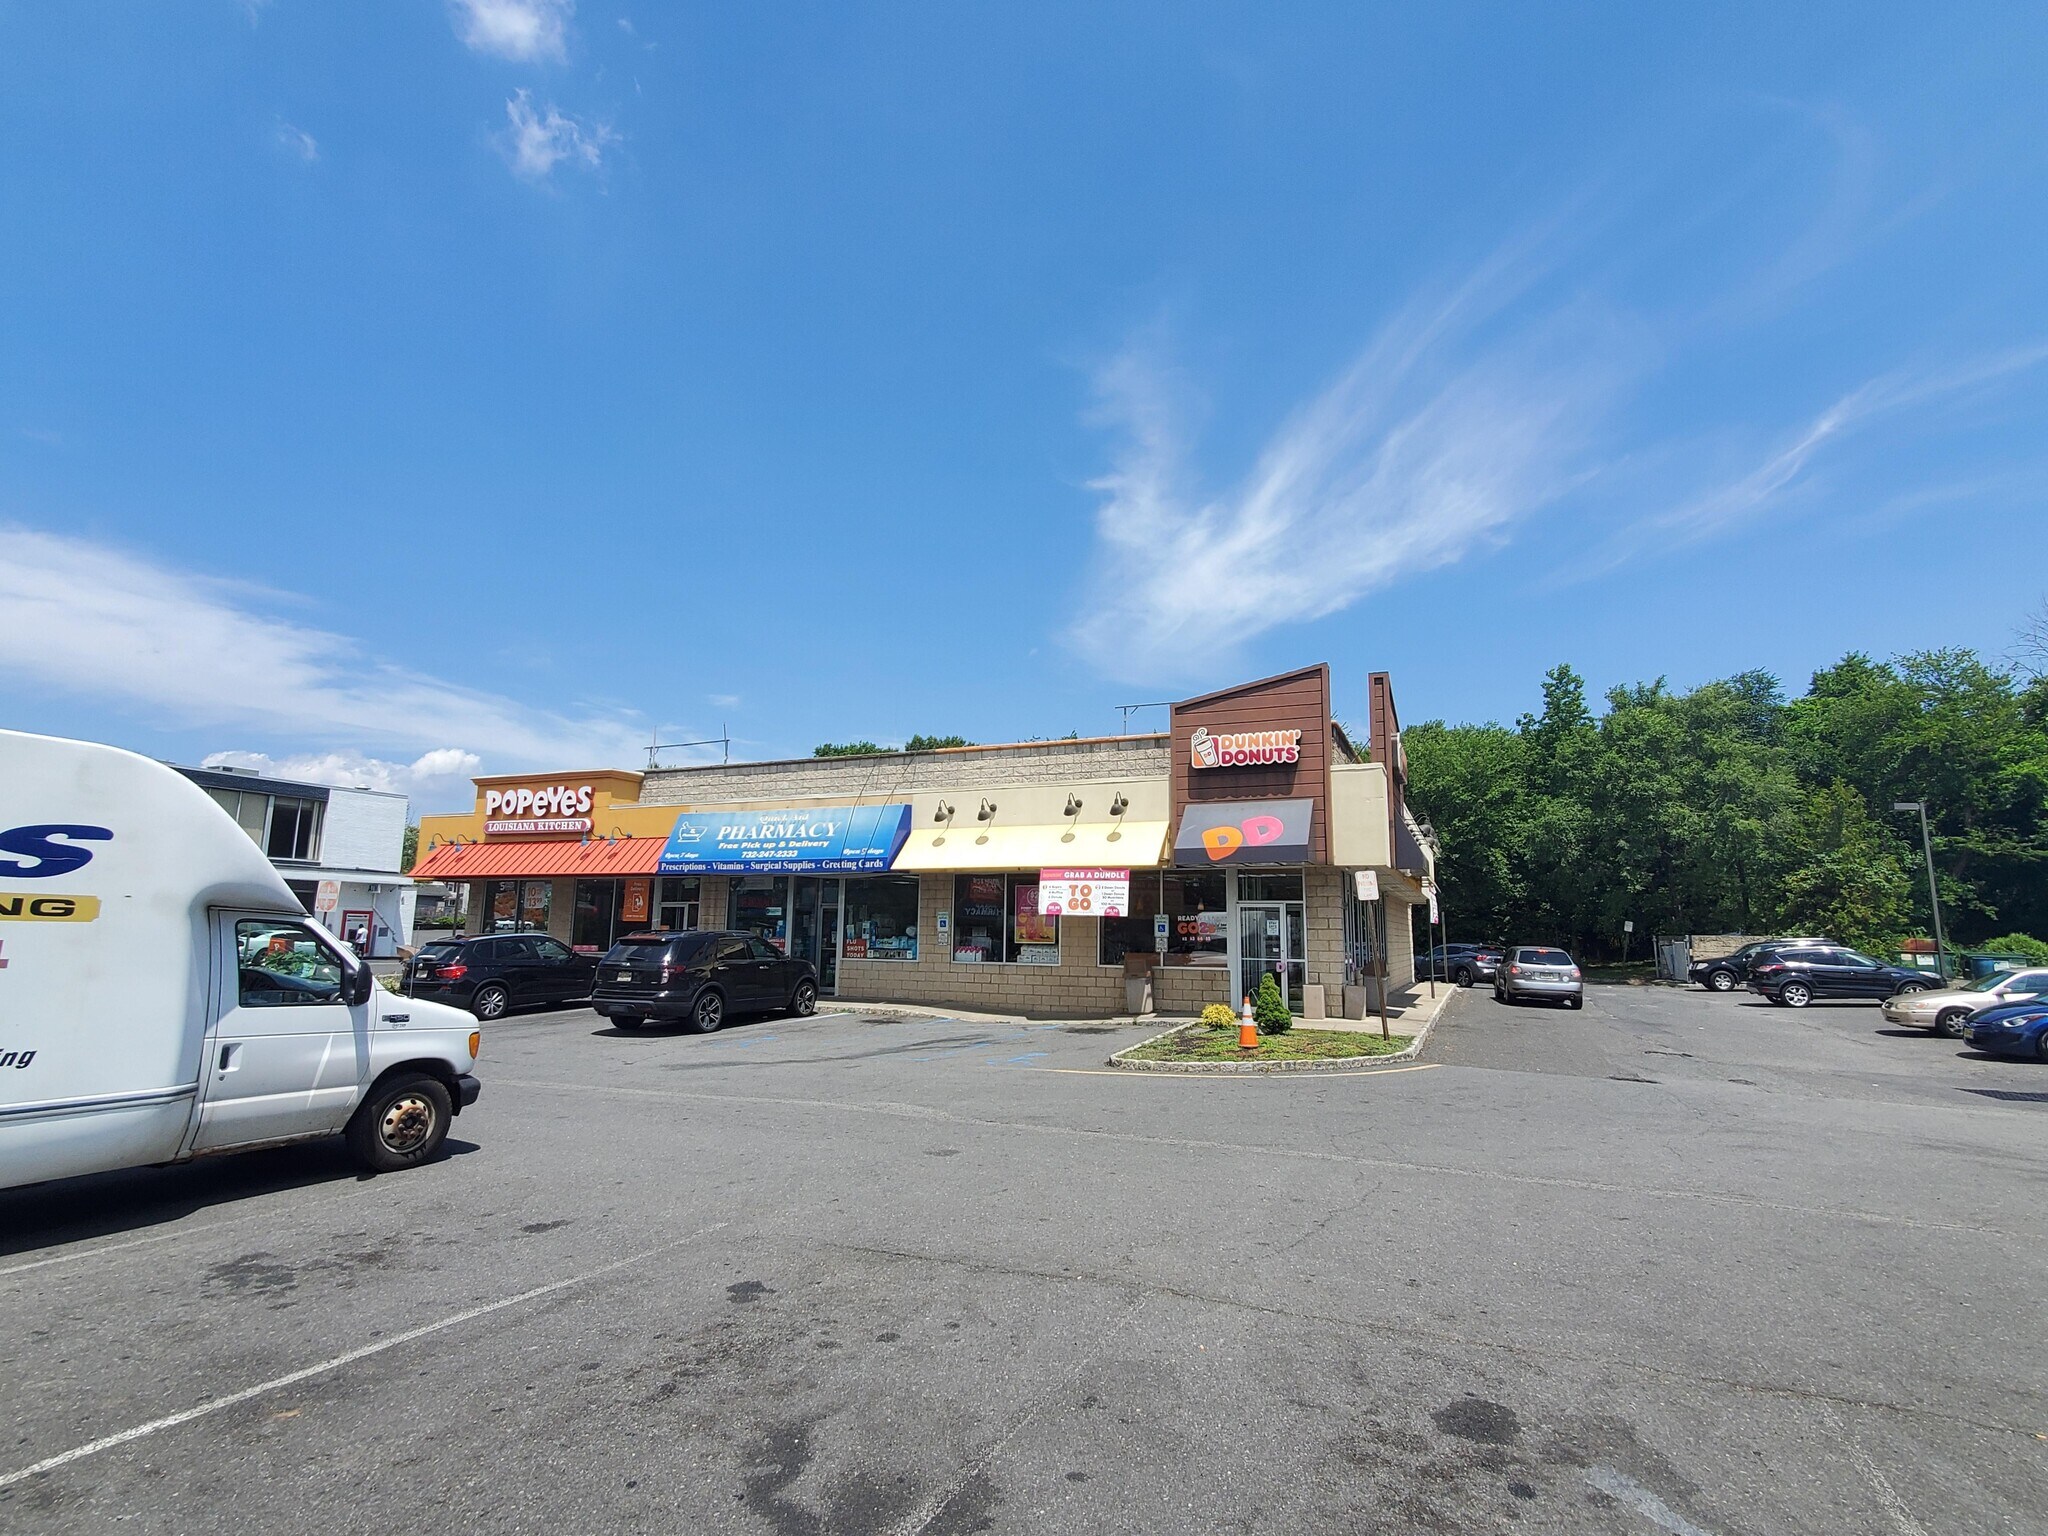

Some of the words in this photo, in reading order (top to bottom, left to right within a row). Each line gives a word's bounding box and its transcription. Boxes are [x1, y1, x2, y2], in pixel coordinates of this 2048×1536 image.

[1221, 747, 1297, 765] DONUTS
[487, 822, 535, 832] LOUISIANA
[536, 821, 583, 831] KITCHEN
[715, 821, 841, 840] PHARMACY
[1202, 815, 1284, 861] DD
[740, 841, 761, 849] Pick
[788, 840, 830, 848] Delivery
[664, 852, 680, 860] Open
[741, 849, 799, 858] 732-247-2333
[843, 848, 861, 856] Open
[867, 847, 885, 855] days
[661, 862, 706, 873] Prescriptions
[712, 862, 745, 871] Vitamins
[750, 861, 781, 871] Surgical
[782, 860, 816, 871] Supplies
[822, 859, 857, 870] Greeting
[858, 859, 884, 868] Cards
[1064, 871, 1085, 879] GRAB
[1086, 871, 1093, 879] A
[1069, 884, 1092, 897] TO
[1068, 898, 1092, 911] GO
